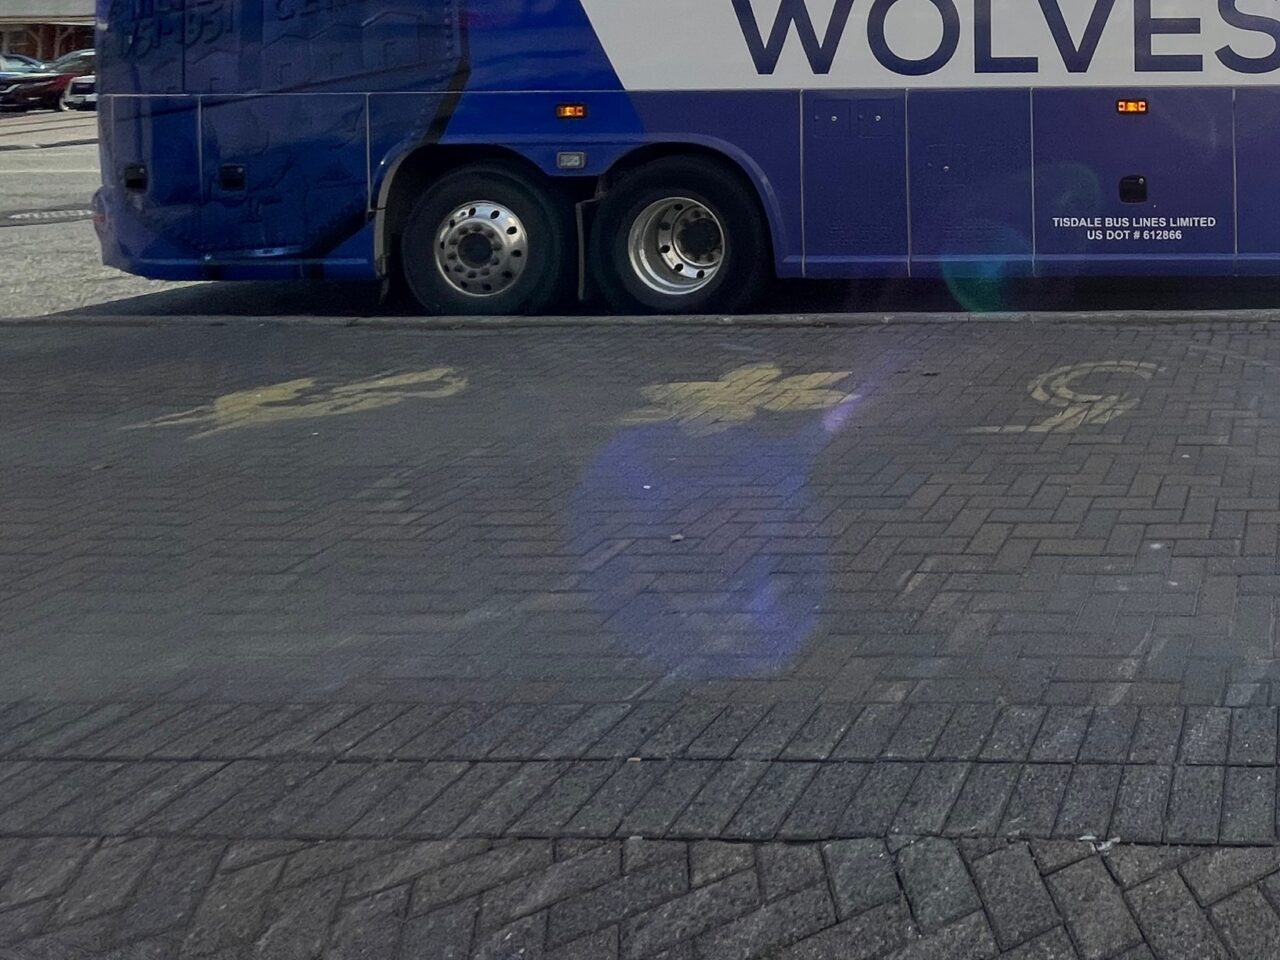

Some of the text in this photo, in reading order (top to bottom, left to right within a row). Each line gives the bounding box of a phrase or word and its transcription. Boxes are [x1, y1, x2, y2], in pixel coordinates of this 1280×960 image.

[1052, 217, 1217, 228] TISDALE BUS LINES LIMITED
[1086, 230, 1182, 241] US DOT # 612866
